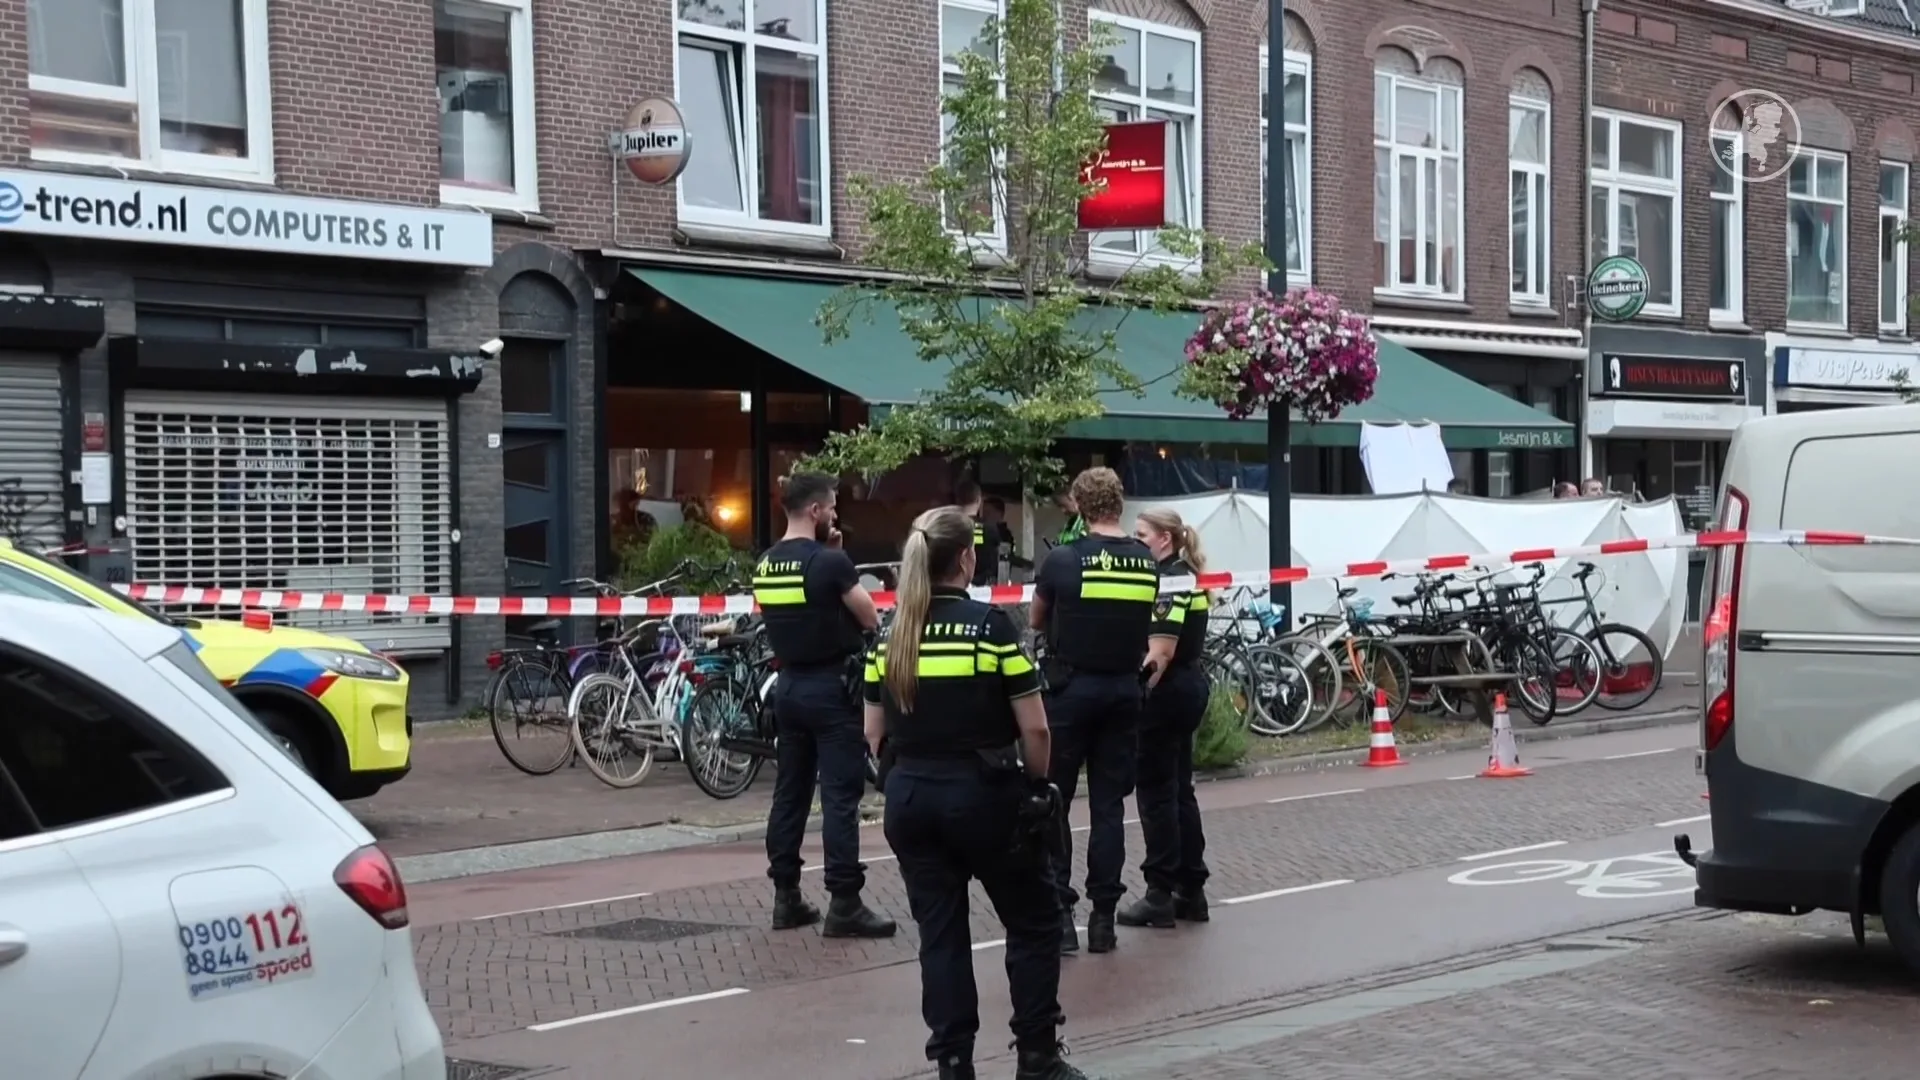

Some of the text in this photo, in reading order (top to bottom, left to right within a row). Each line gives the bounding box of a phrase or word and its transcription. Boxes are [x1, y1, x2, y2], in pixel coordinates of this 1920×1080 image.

[625, 132, 679, 153] Jupiler
[206, 205, 388, 248] COMPUTERS
[397, 225, 414, 249] &
[423, 222, 445, 251] IT
[1592, 282, 1640, 295] Heineken
[1497, 431, 1541, 447] Jasmijn
[1542, 431, 1551, 446] &
[1091, 550, 1150, 569] POLITIE
[925, 622, 965, 636] ITIE
[180, 903, 308, 952] 0900 112
[186, 943, 249, 975] 8844
[191, 947, 313, 997] geen spoed spoed
